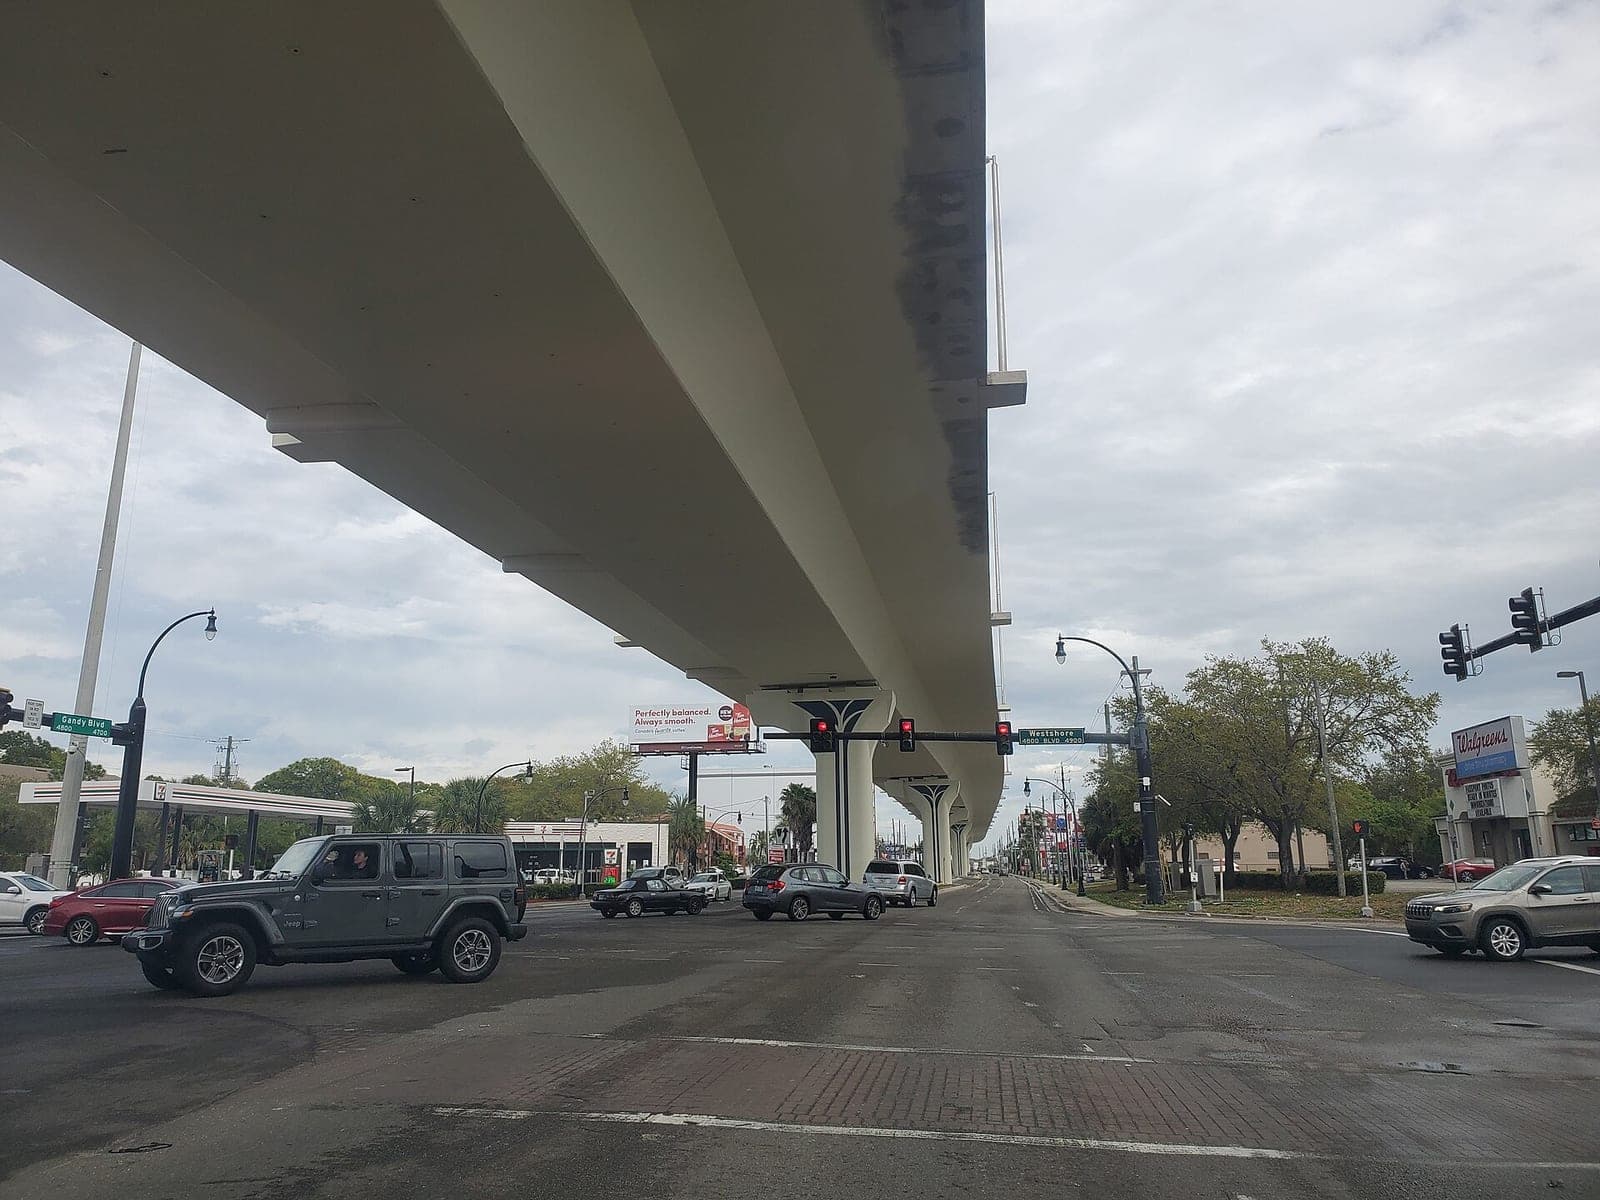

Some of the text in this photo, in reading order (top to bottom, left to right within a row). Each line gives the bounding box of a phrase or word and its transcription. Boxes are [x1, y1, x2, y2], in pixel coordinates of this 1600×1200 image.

[635, 709, 670, 718] Perfectly
[62, 716, 104, 728] Gandy Blvd
[635, 718, 662, 726] Always
[1457, 728, 1508, 756] Walgreens
